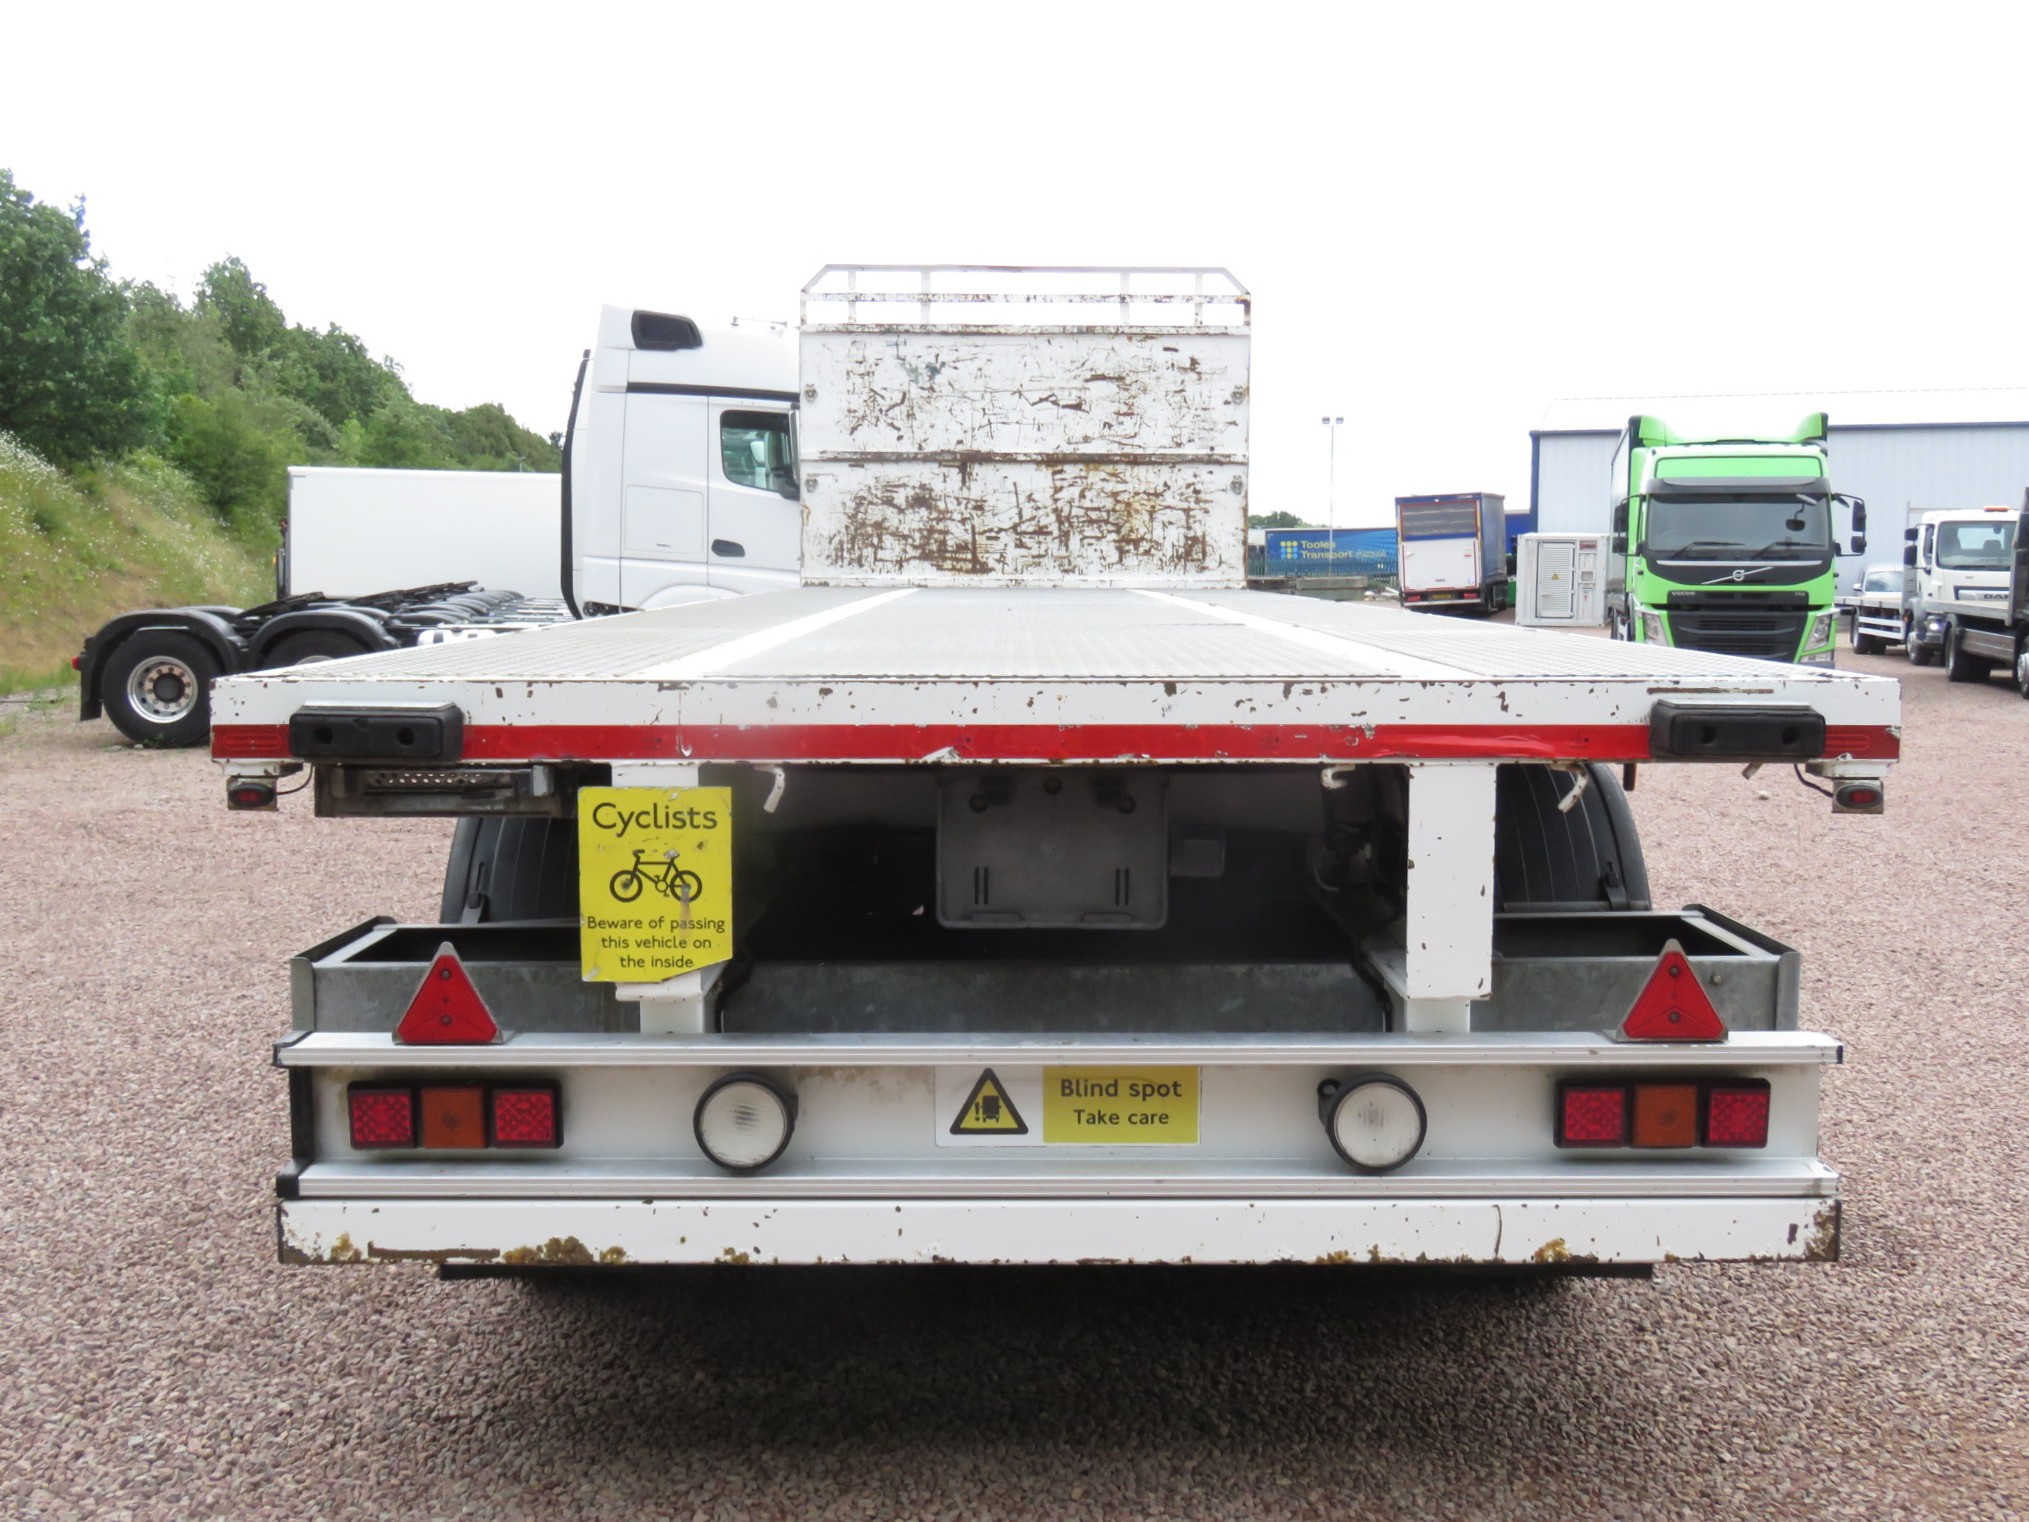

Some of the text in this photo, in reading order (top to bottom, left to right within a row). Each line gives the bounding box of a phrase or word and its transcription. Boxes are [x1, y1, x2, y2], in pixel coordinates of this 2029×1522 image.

[1300, 540, 1336, 549] Tooles
[1300, 550, 1353, 559] Transport
[592, 802, 718, 838] Cyclists
[587, 916, 725, 933] Beware of passing
[601, 936, 712, 949] this vehicle on
[620, 956, 694, 968] the inside
[1060, 1079, 1182, 1101] Blind spot
[1073, 1109, 1170, 1125] Take care
